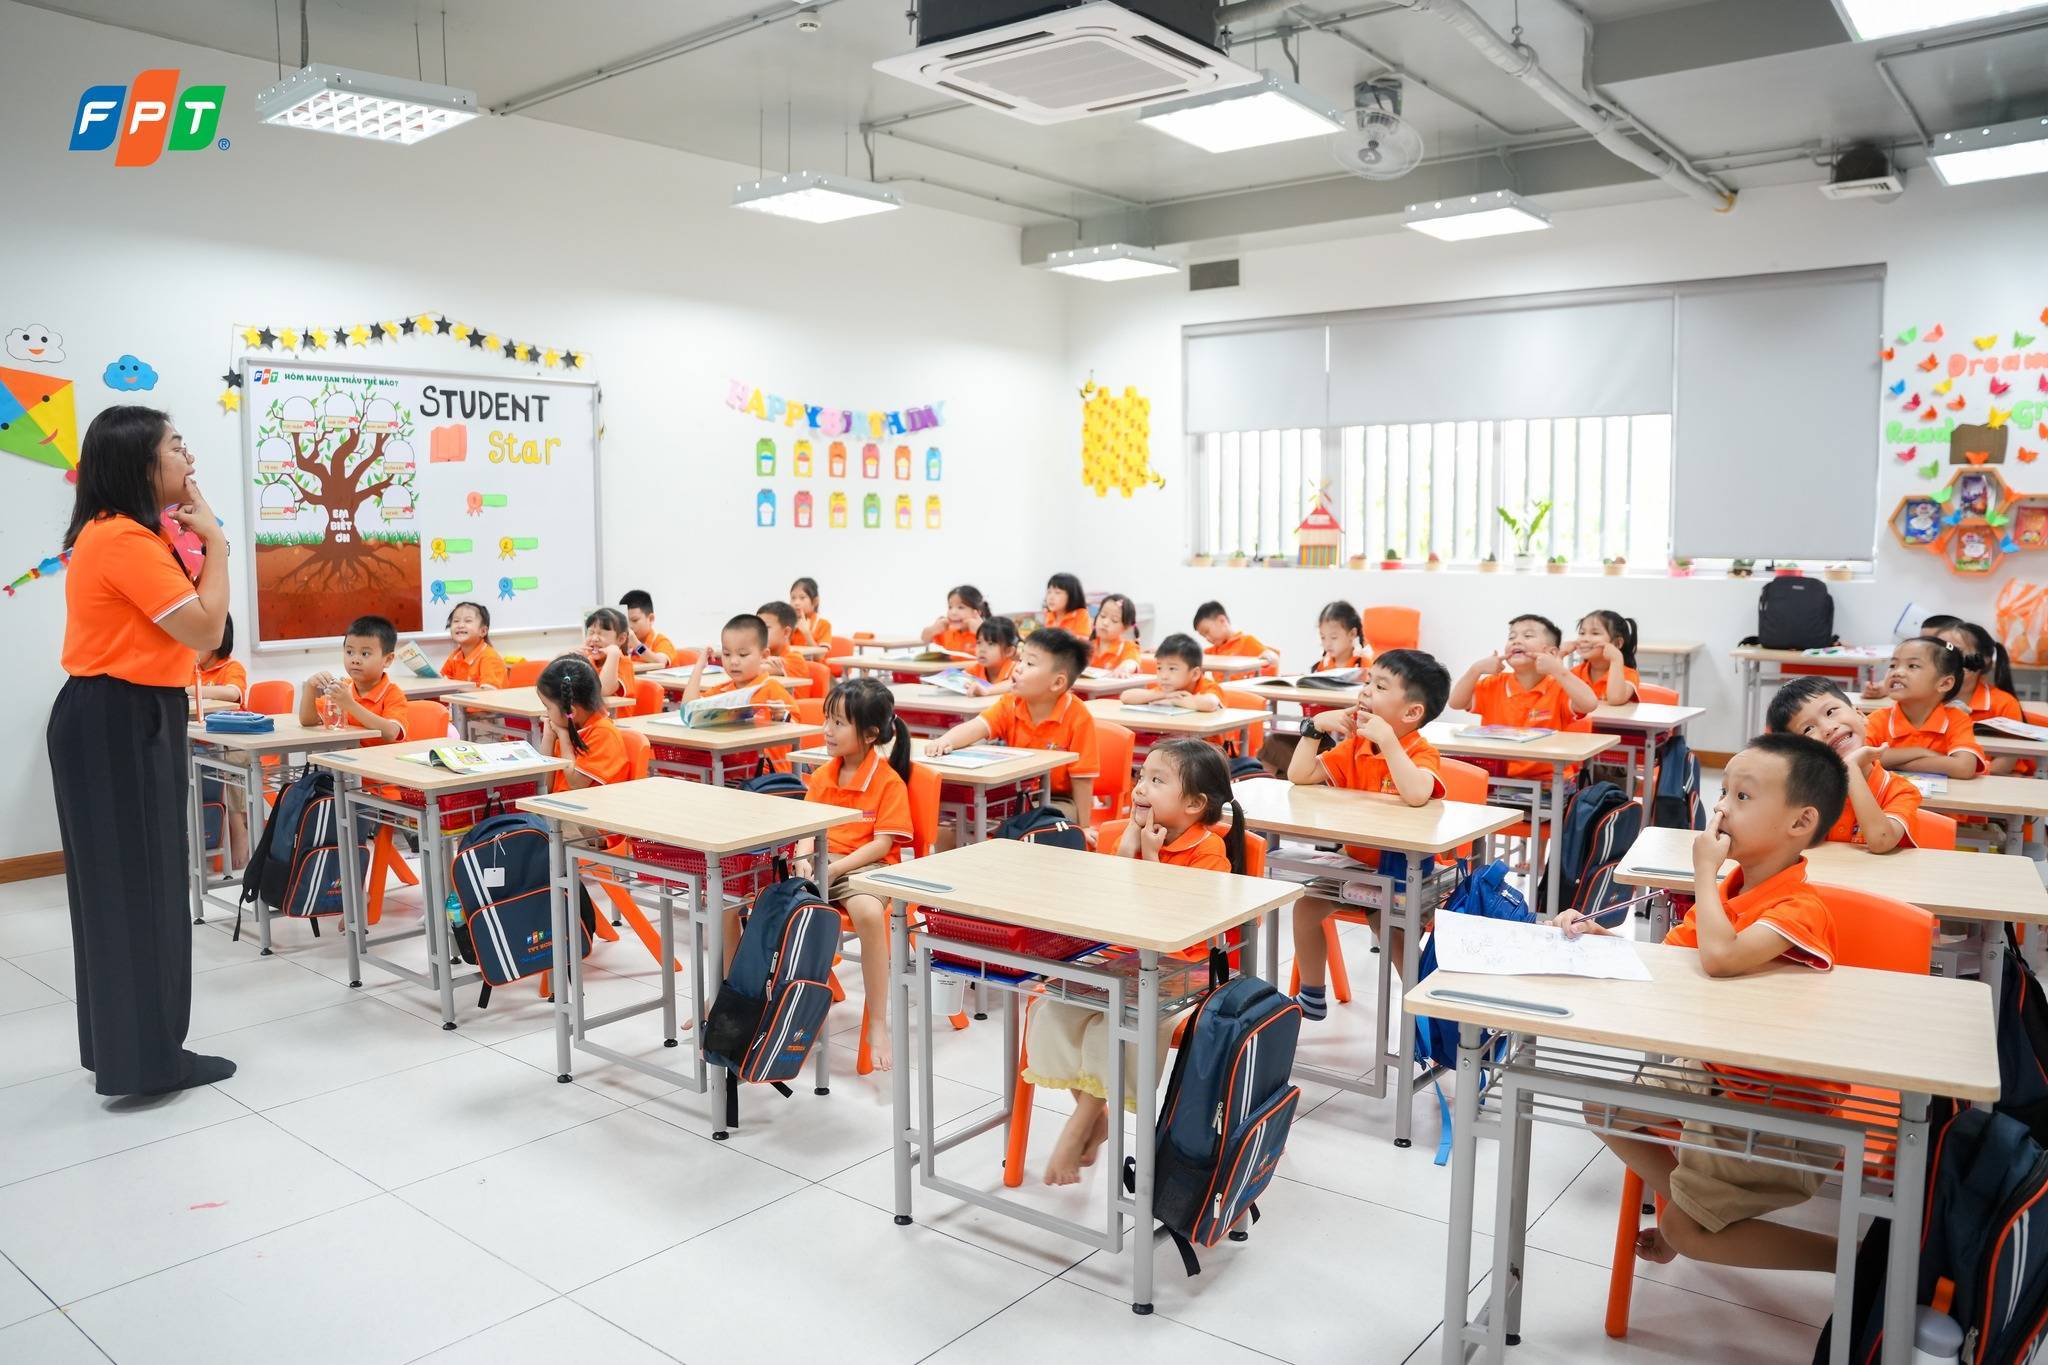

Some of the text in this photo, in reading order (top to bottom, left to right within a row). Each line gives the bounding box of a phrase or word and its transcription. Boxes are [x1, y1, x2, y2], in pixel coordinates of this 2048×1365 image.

[254, 370, 278, 384] FPT
[420, 385, 550, 422] STUDENT
[1886, 417, 1954, 444] Read
[488, 430, 562, 465] Star
